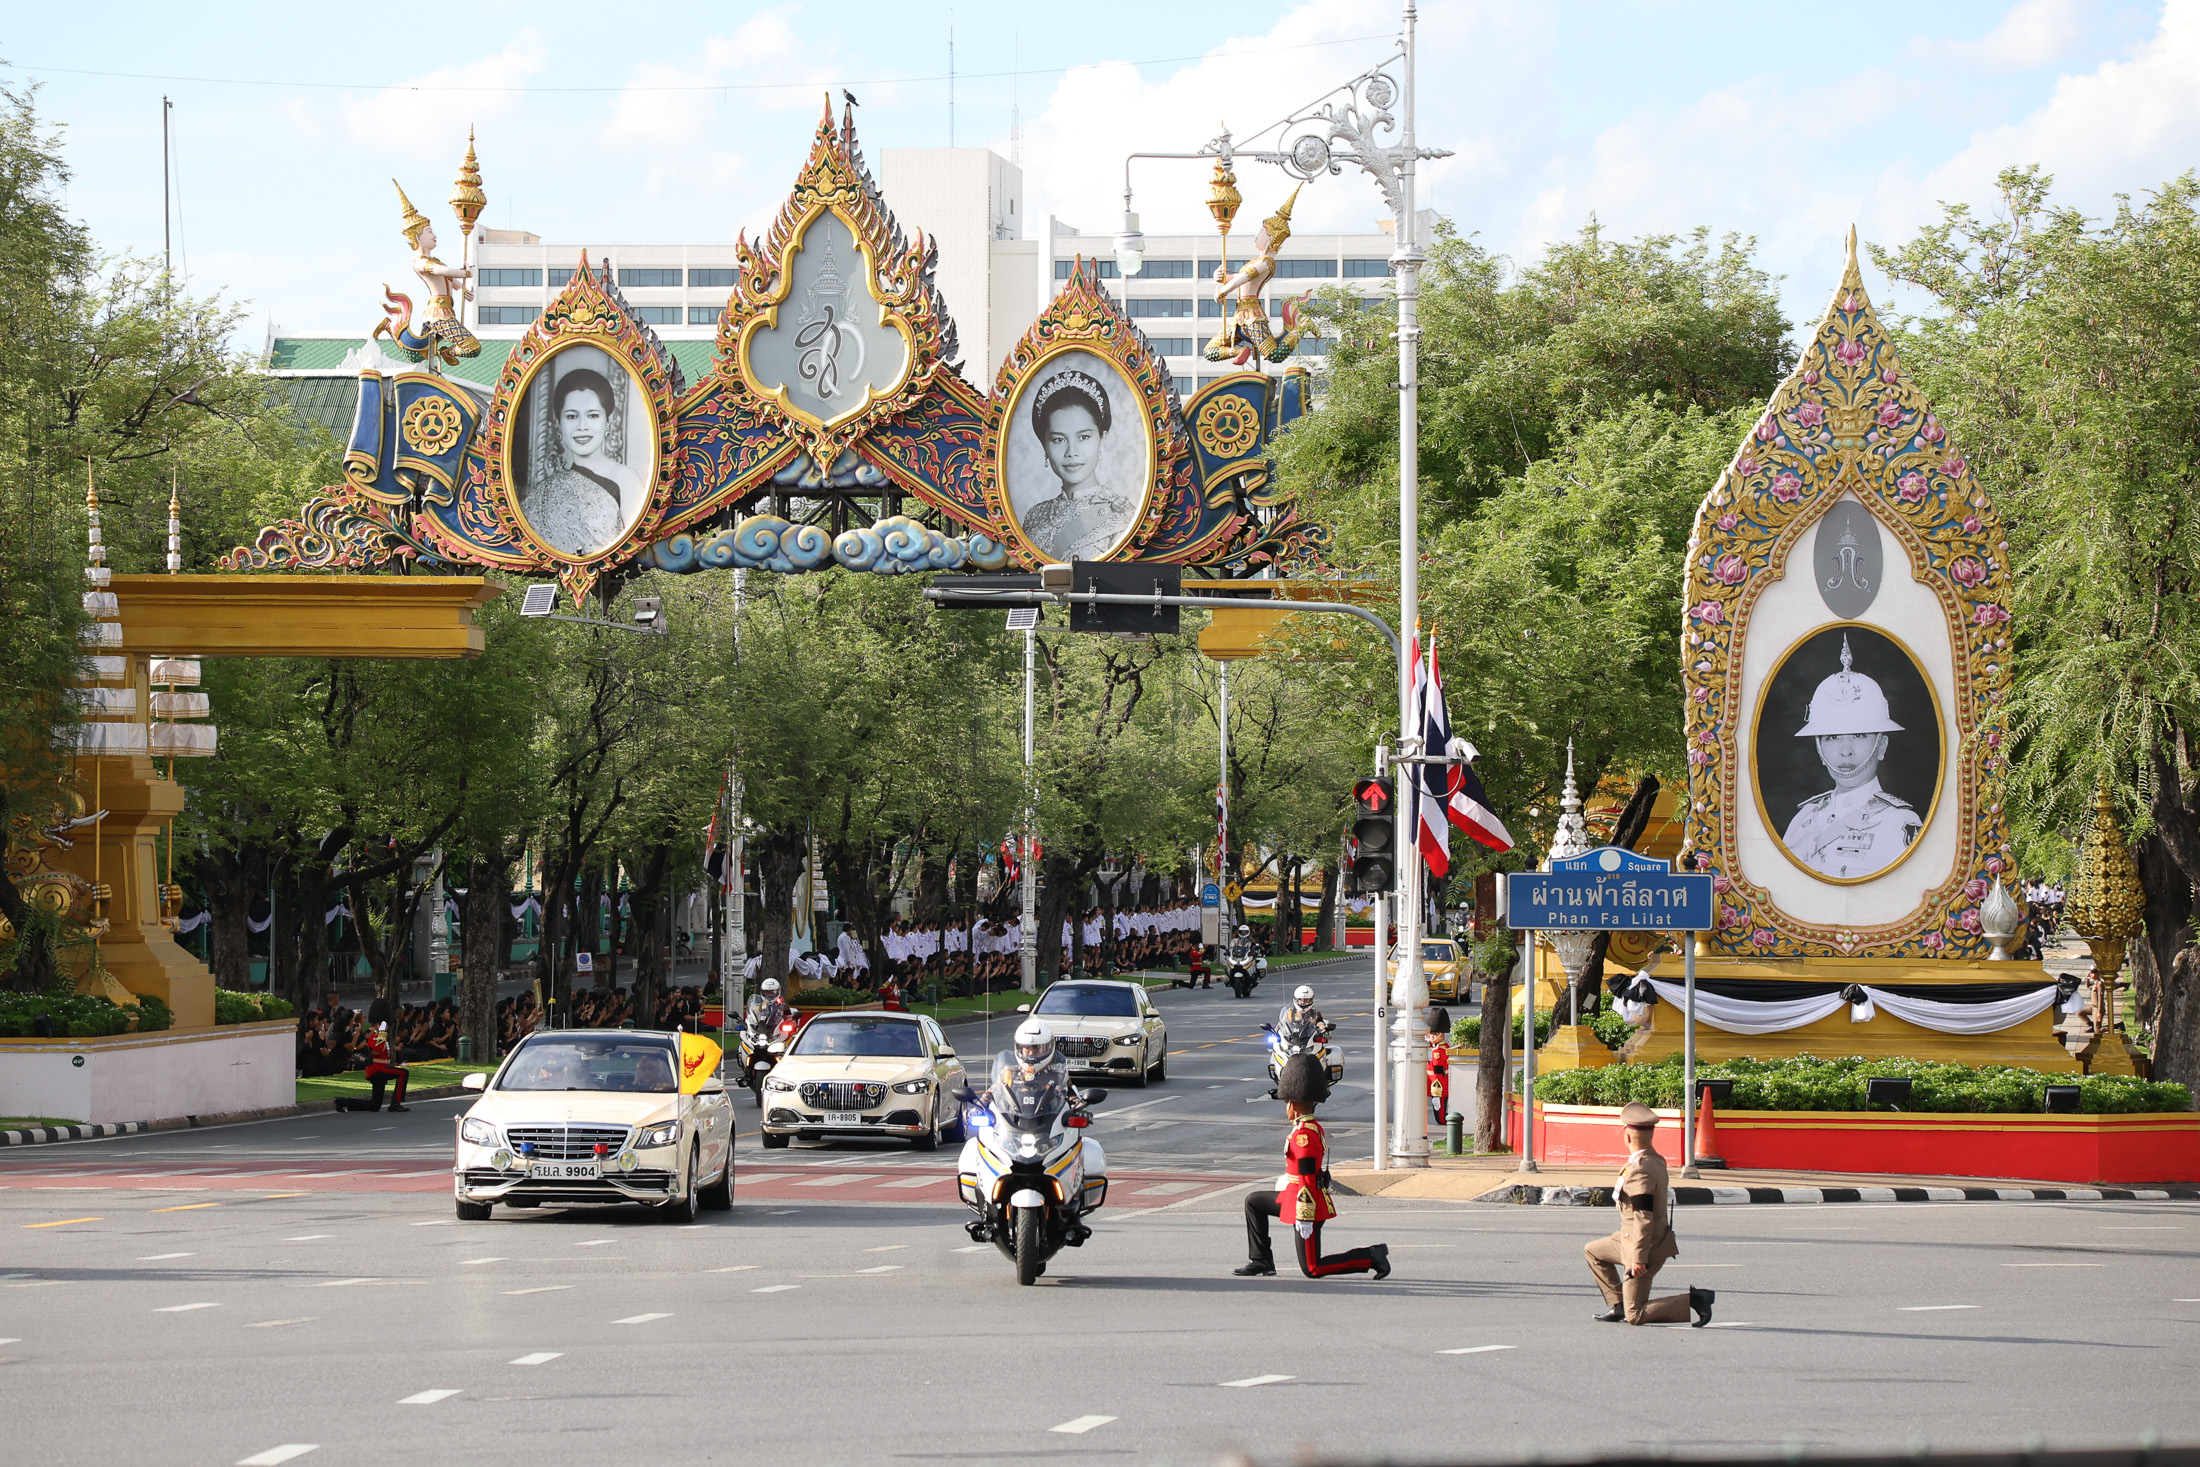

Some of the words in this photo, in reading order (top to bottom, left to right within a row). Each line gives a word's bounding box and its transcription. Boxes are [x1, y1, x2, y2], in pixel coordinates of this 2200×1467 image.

[1565, 861, 1587, 871] แยก
[1628, 862, 1661, 872] Square
[1532, 876, 1688, 907] ผ่านฟ้าลีลาศ
[1549, 912, 1589, 924] Phan
[1601, 913, 1619, 925] Fa
[1632, 913, 1672, 925] Lilat
[1378, 1006, 1385, 1018] 6
[1023, 1096, 1035, 1105] 05
[534, 1166, 562, 1177] ร.ย.ล.
[566, 1166, 595, 1177] 9904
